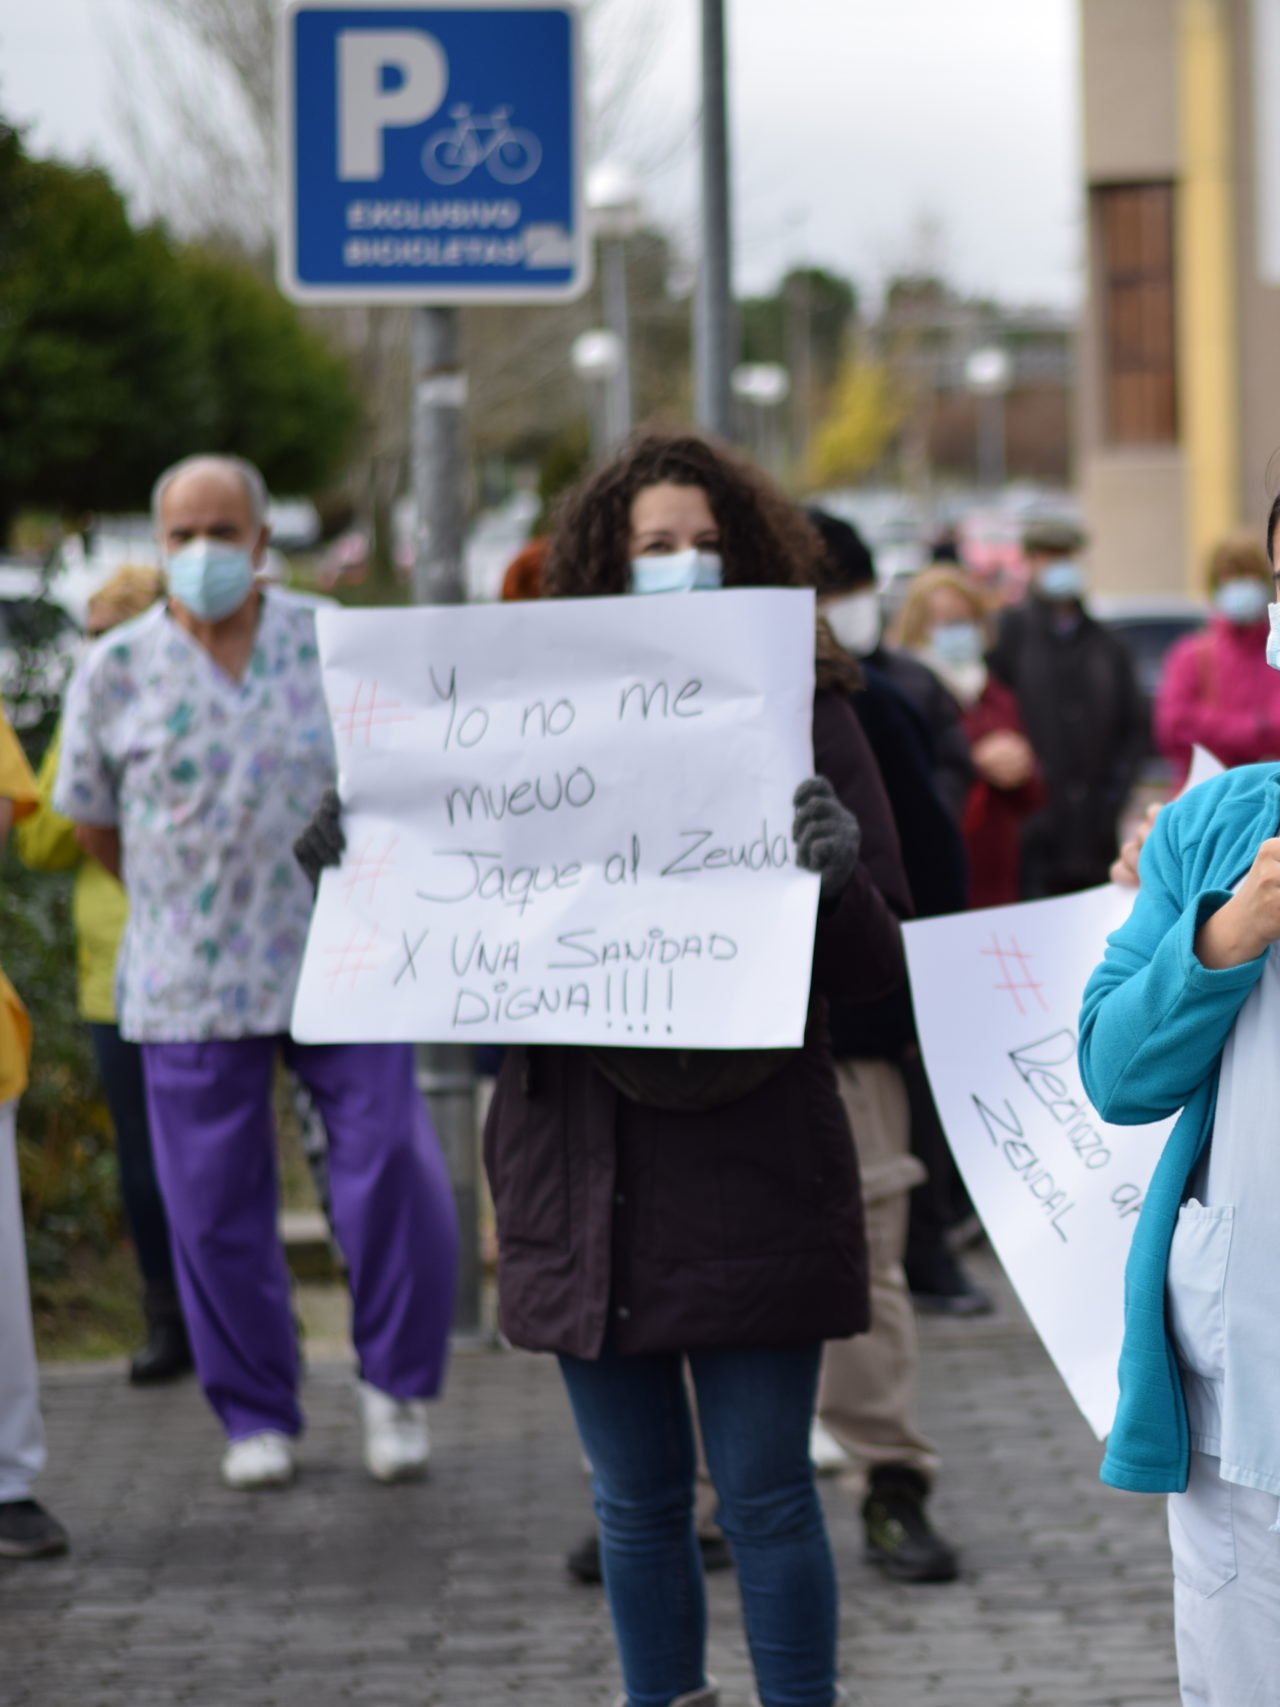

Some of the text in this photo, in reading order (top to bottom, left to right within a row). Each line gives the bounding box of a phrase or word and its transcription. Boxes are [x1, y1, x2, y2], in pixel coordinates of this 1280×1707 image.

[337, 28, 449, 182] P
[343, 235, 524, 267] BICICLETAS
[346, 199, 521, 230] EXCLUSIVO
[430, 664, 490, 751] Yo
[520, 698, 576, 737] no
[618, 676, 704, 721] me
[416, 849, 583, 916] Jaque
[604, 832, 640, 885] al
[971, 1092, 1076, 1243] ZENDAL
